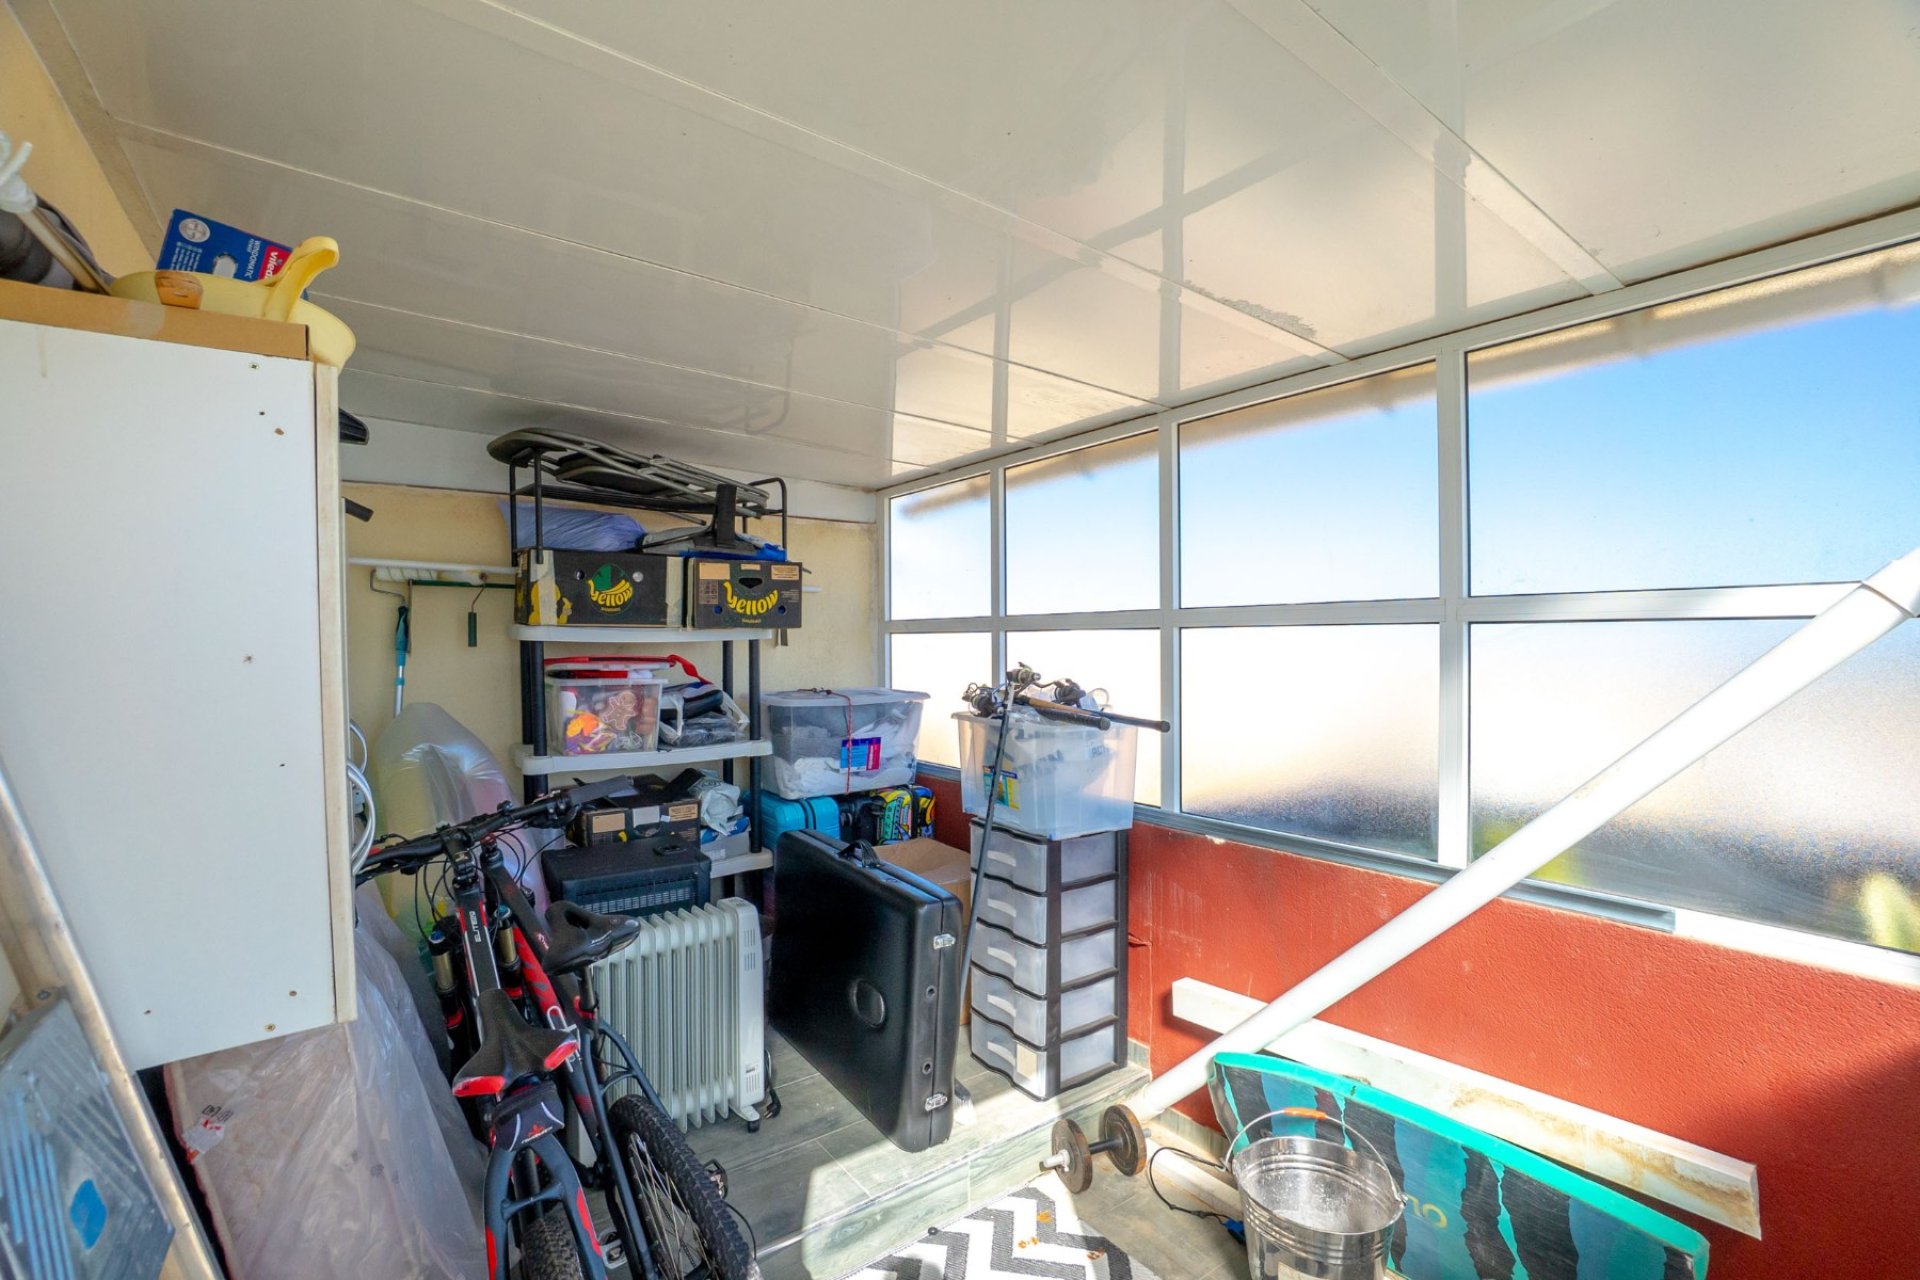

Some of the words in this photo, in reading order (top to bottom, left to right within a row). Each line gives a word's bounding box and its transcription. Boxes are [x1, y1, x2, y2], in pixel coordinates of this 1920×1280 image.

[264, 251, 281, 279] viled
[588, 579, 633, 607] yellow
[723, 581, 779, 616] yellow
